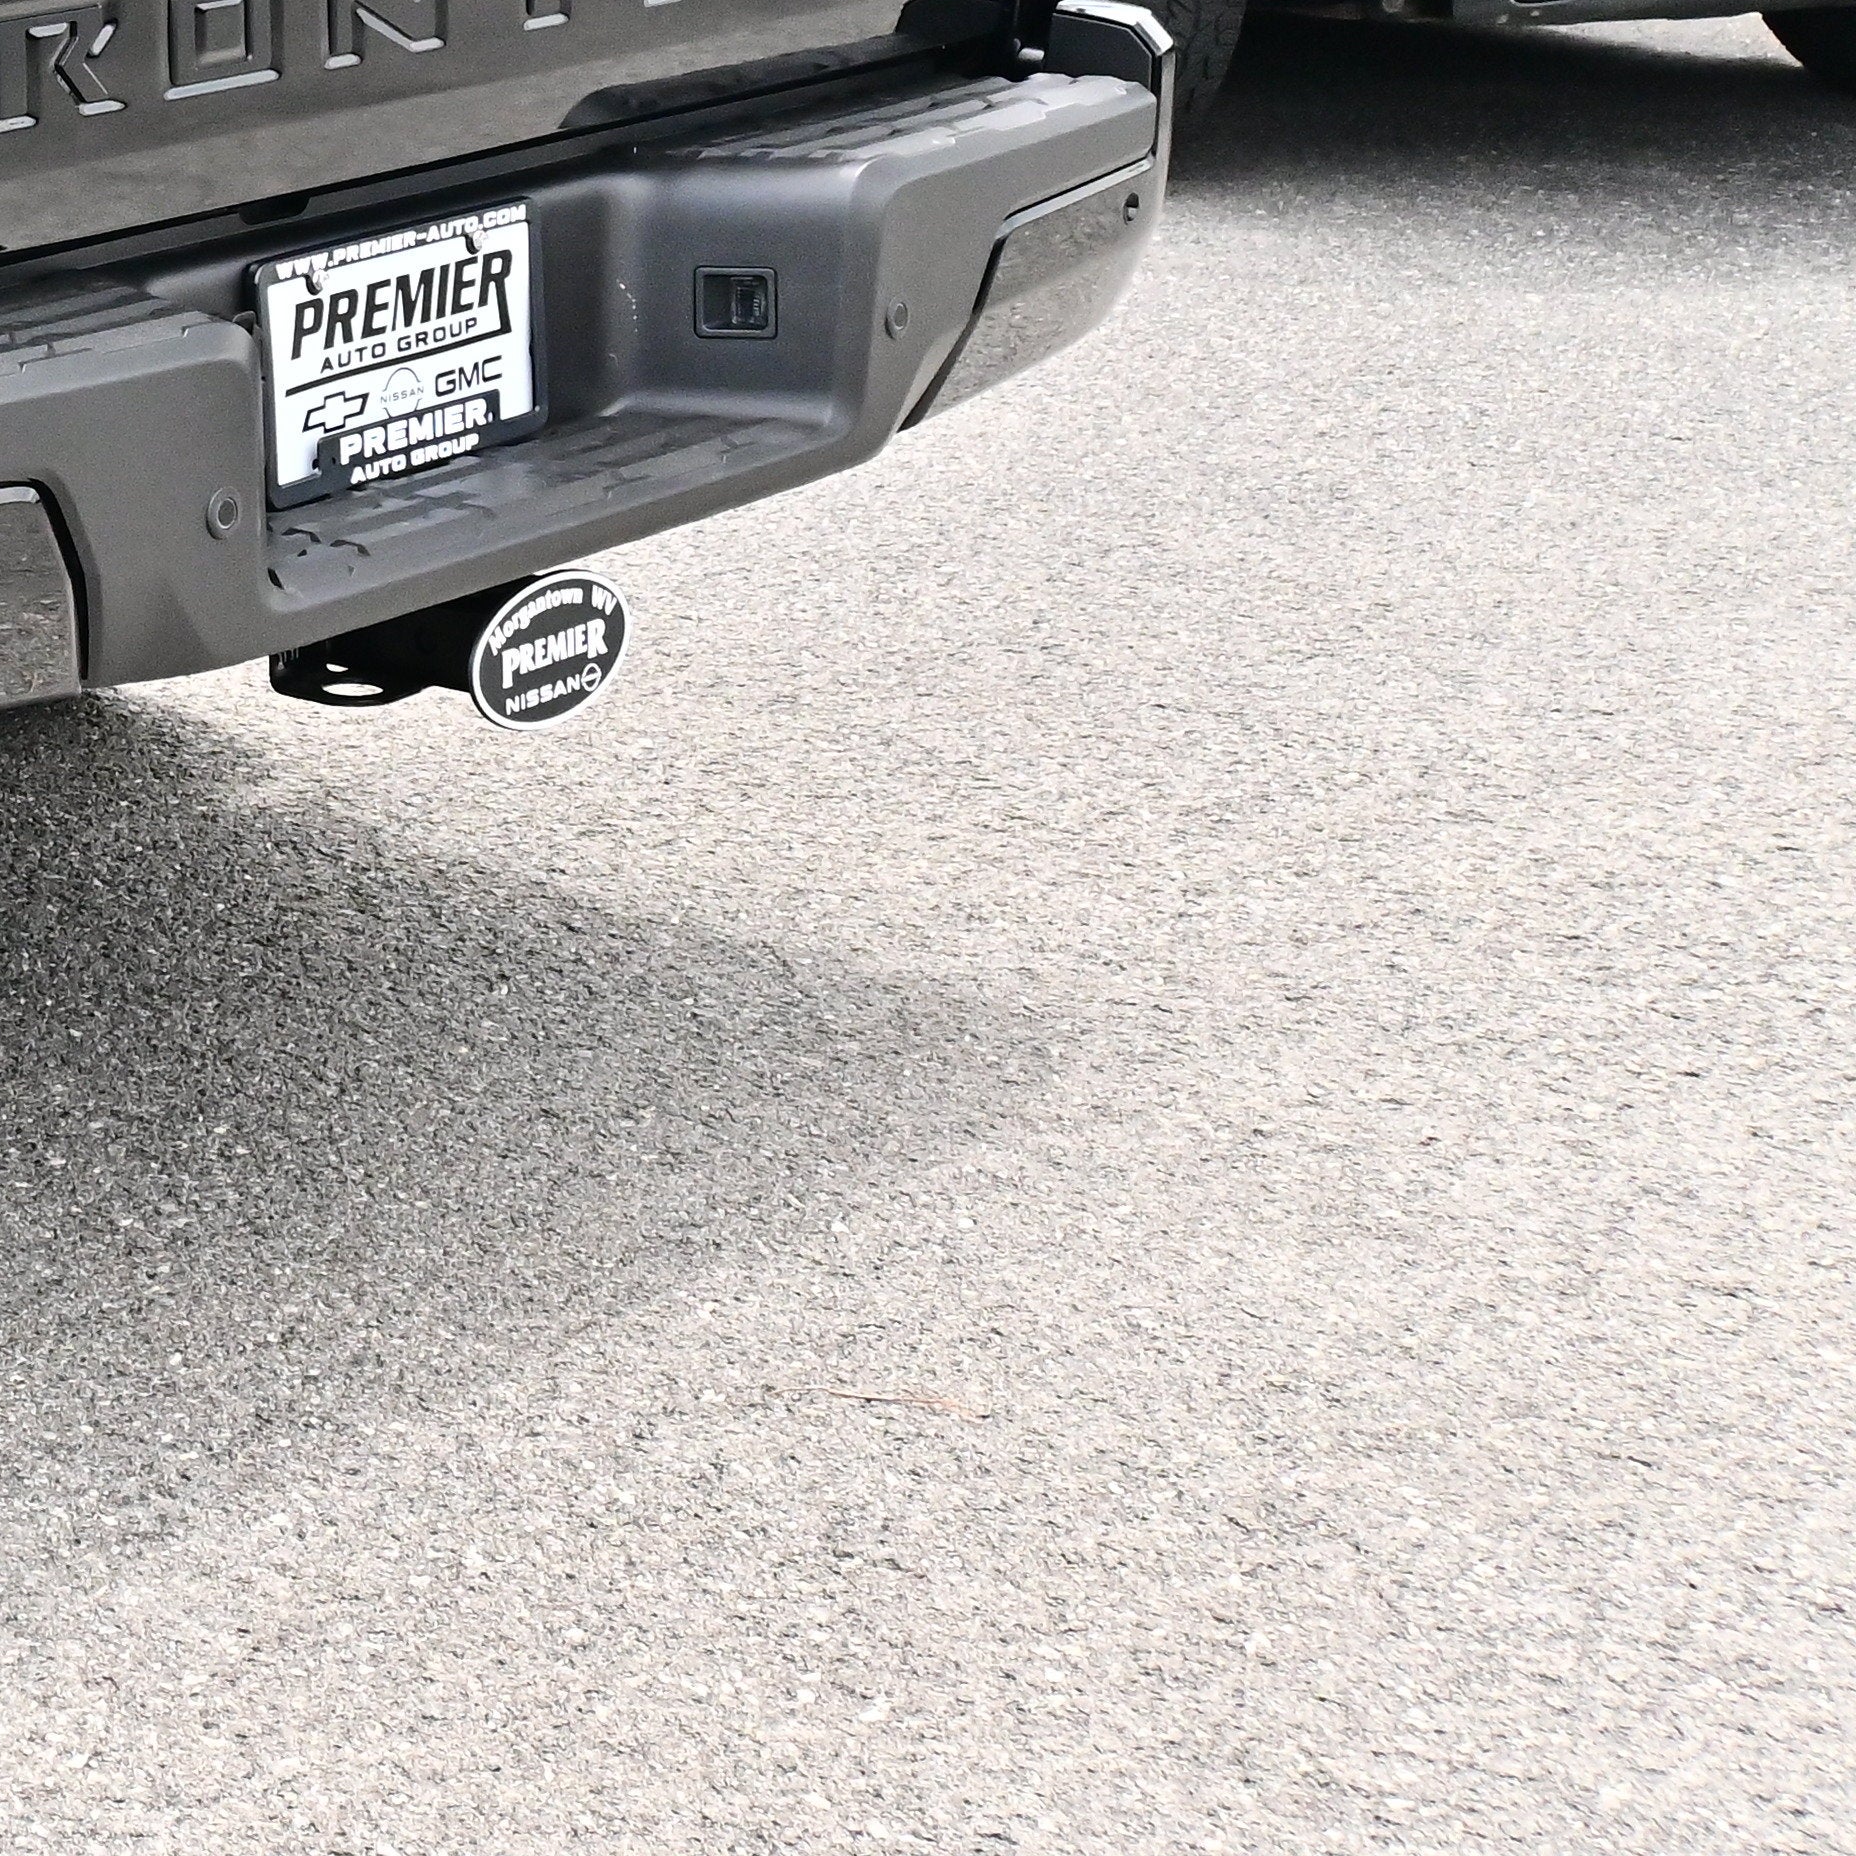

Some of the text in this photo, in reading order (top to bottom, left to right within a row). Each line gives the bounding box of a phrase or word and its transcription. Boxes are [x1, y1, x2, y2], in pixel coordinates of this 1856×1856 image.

[274, 203, 527, 280] WWW.PREMIER-AUTO.COM
[290, 249, 513, 361] PREMIER
[320, 317, 478, 374] AUTO GROUP
[379, 355, 503, 404] NISSAN GMC
[339, 397, 488, 465] PREMIER
[350, 432, 480, 484] AUTO GROUP
[487, 584, 618, 656] Morgantown WV
[501, 618, 609, 690] PREMIER
[505, 673, 581, 716] NISSAN
